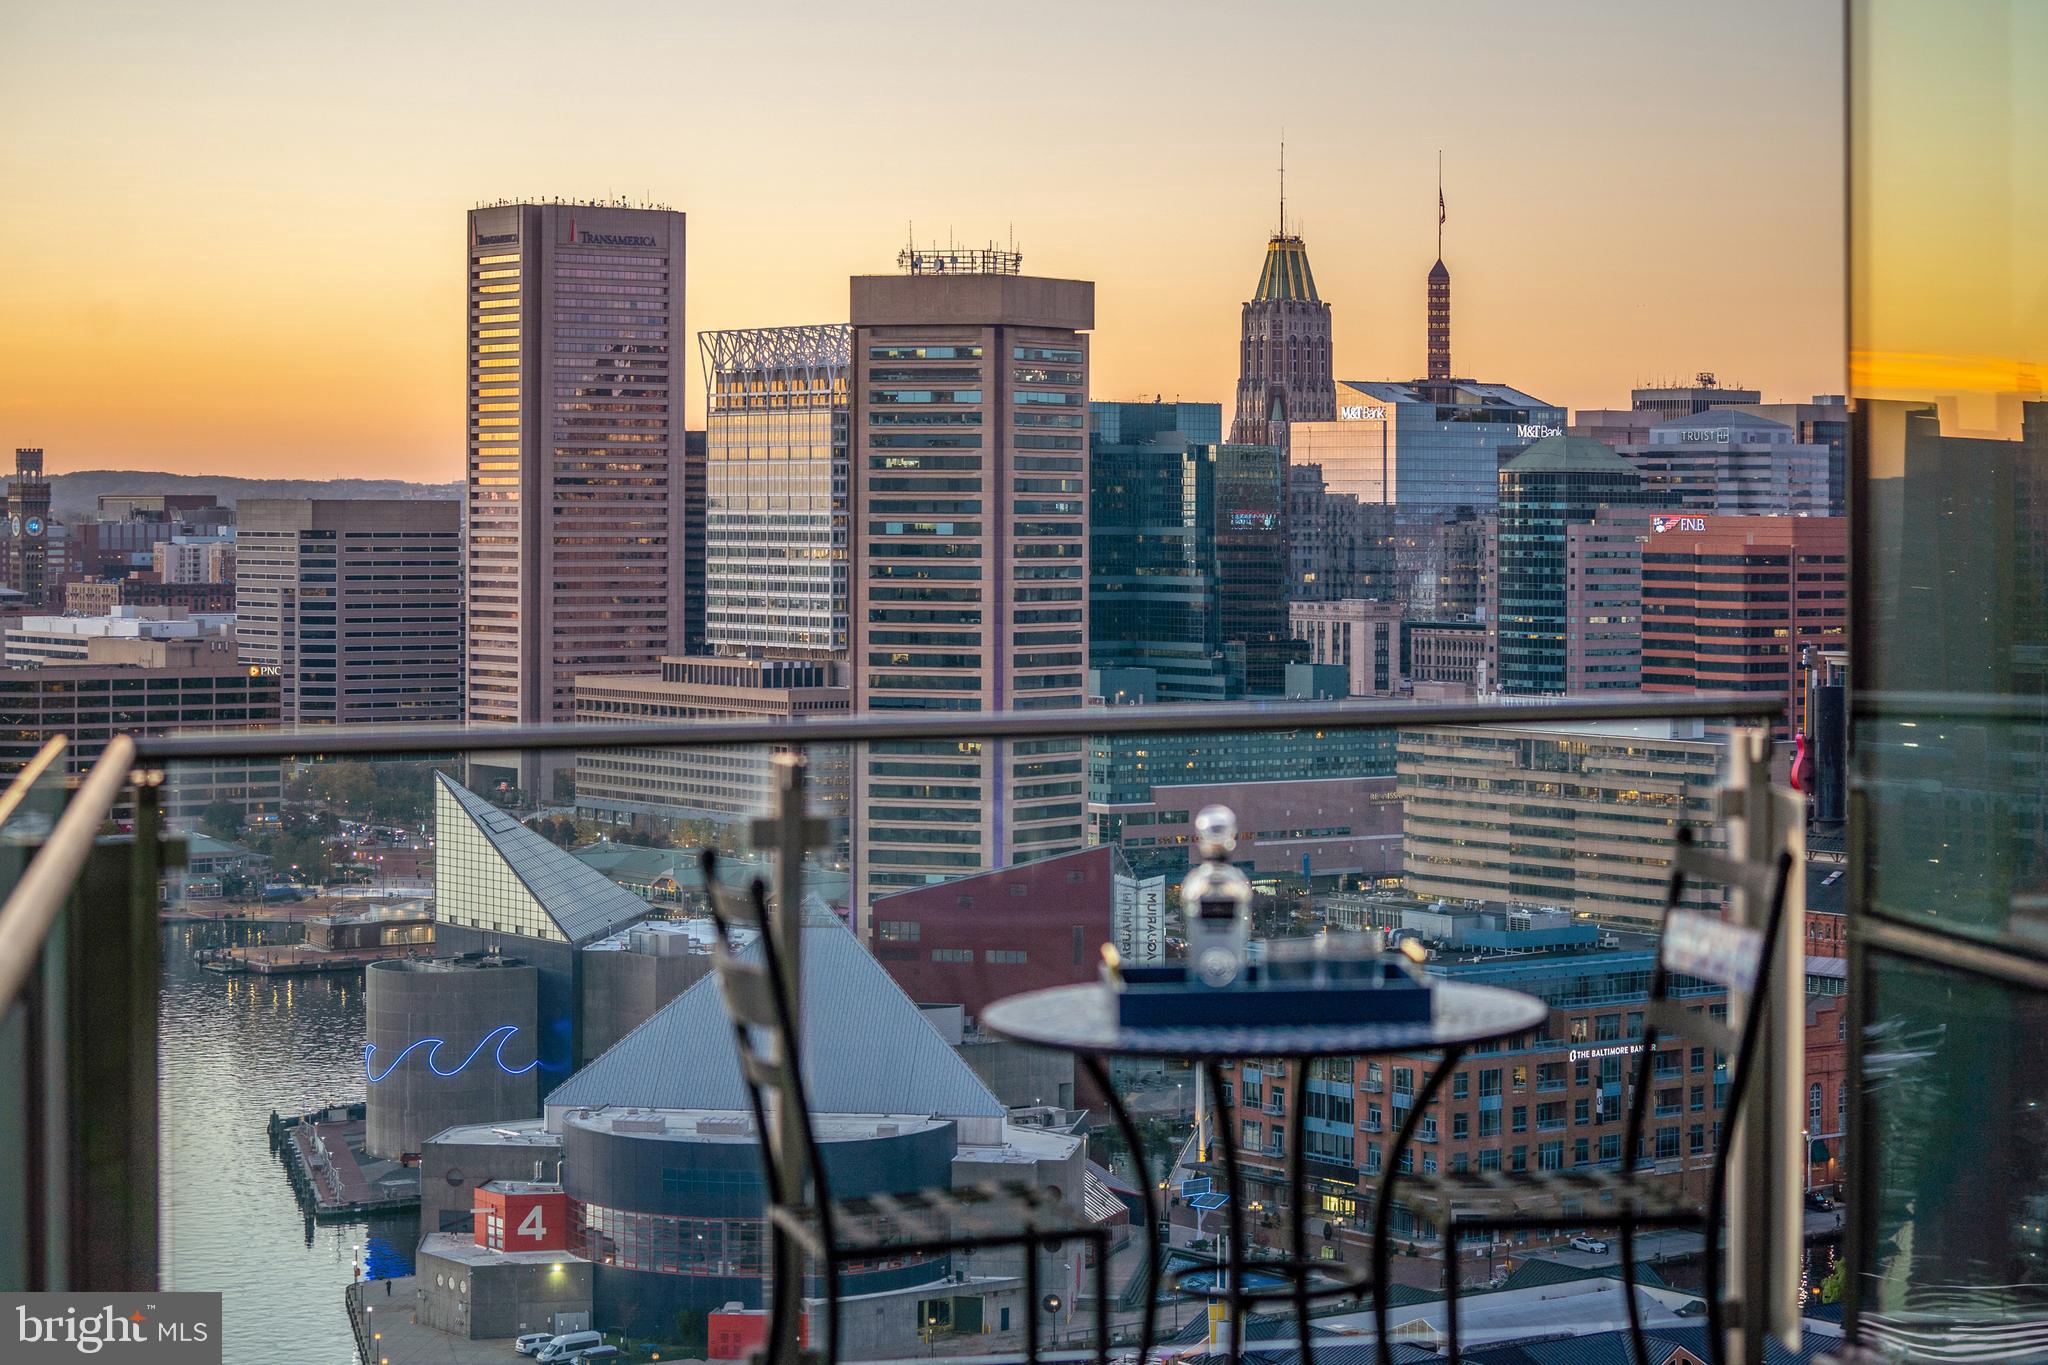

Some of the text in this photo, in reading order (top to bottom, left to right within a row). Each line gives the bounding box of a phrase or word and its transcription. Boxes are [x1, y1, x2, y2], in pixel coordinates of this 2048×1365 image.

[1517, 424, 1563, 438] M&T Bank
[1680, 431, 1715, 441] TRUIST
[260, 666, 282, 676] PNC
[1576, 1043, 1657, 1060] THE BALTIMORE BANR
[517, 1205, 547, 1241] 4
